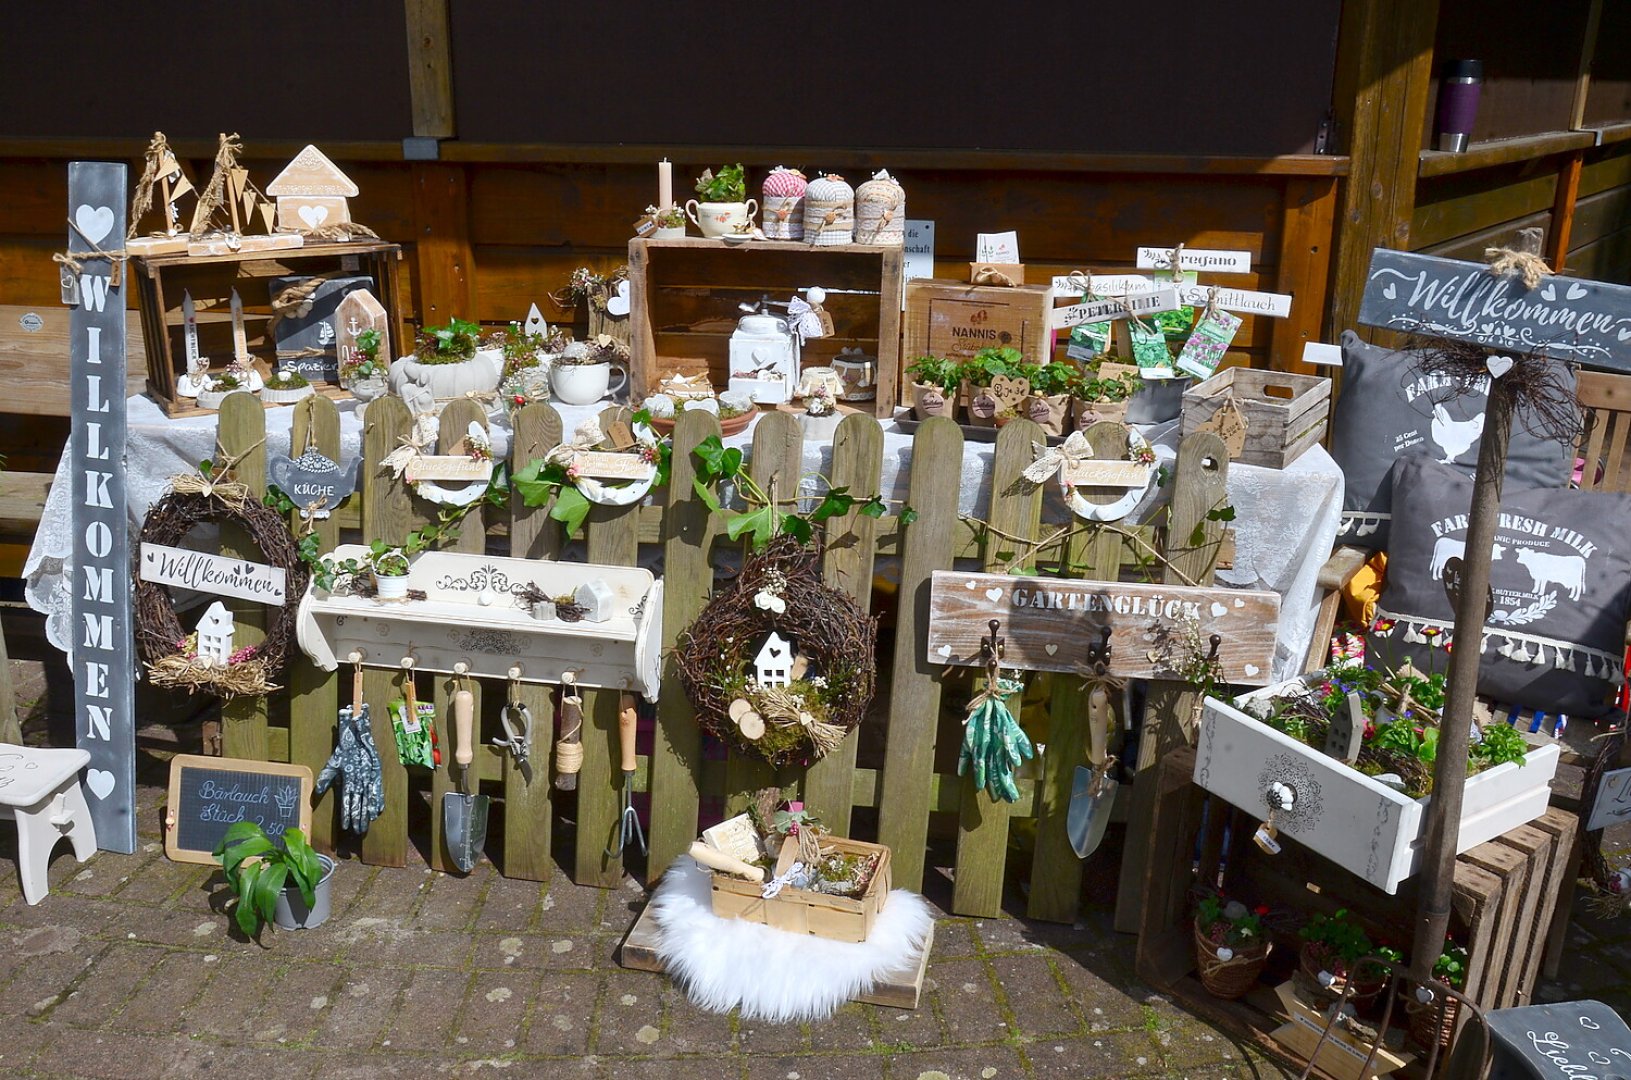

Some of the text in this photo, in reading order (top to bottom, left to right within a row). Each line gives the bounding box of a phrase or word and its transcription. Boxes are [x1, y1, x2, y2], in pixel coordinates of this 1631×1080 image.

[904, 245, 930, 253] nschaft
[1180, 255, 1236, 267] regano
[1079, 296, 1160, 319] PETERILIE
[1407, 271, 1616, 335] Willkommen
[952, 326, 996, 340] NANNIS
[294, 483, 334, 496] KÜCHE
[80, 274, 114, 741] WILLKOMMEN
[1431, 513, 1598, 559] FAR RESH MILK
[1512, 538, 1551, 547] PRODUCE
[160, 553, 274, 593] Willkommen
[1012, 588, 1201, 620] GARTENGLÜCK
[199, 780, 271, 804] Bärlauch
[200, 803, 245, 822] Stück
